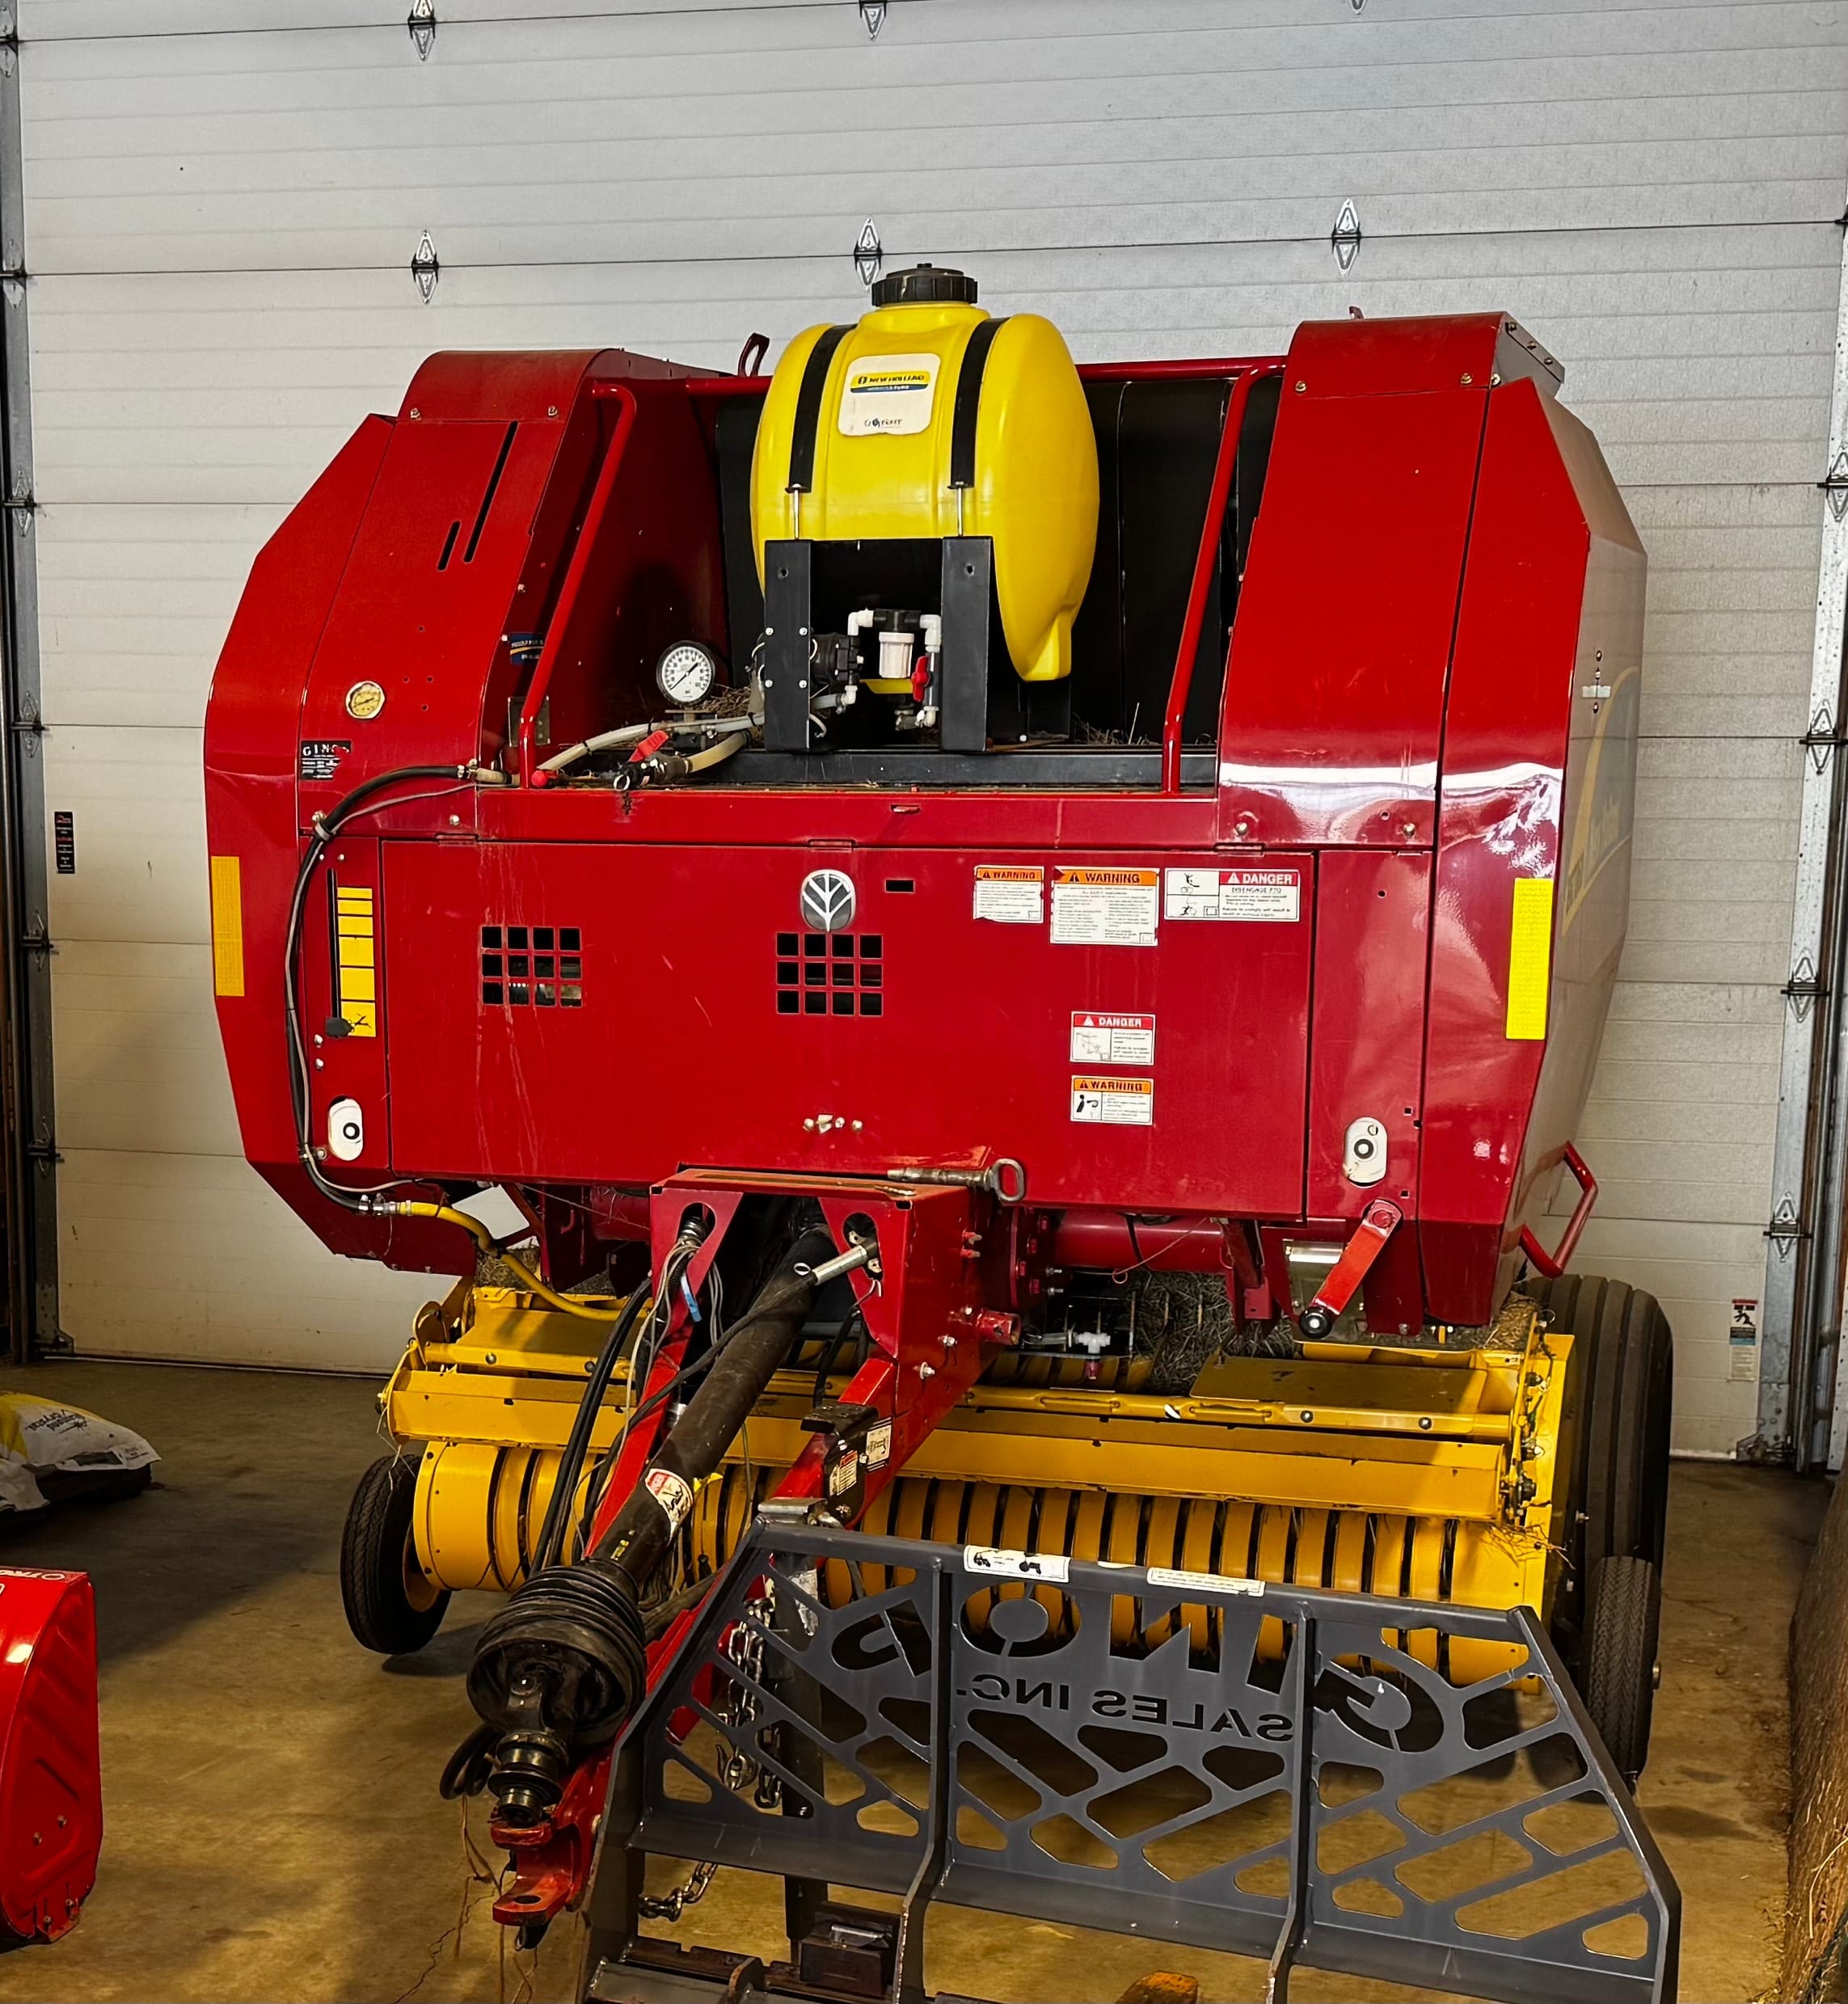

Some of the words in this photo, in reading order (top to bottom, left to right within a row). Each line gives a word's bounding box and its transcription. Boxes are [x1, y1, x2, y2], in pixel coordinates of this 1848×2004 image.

[993, 871, 1036, 880] WARNING
[1086, 872, 1141, 884] WARNING
[1242, 872, 1293, 884] DANGER
[1099, 1016, 1142, 1027] DANGER
[1090, 1080, 1143, 1091] WARNING
